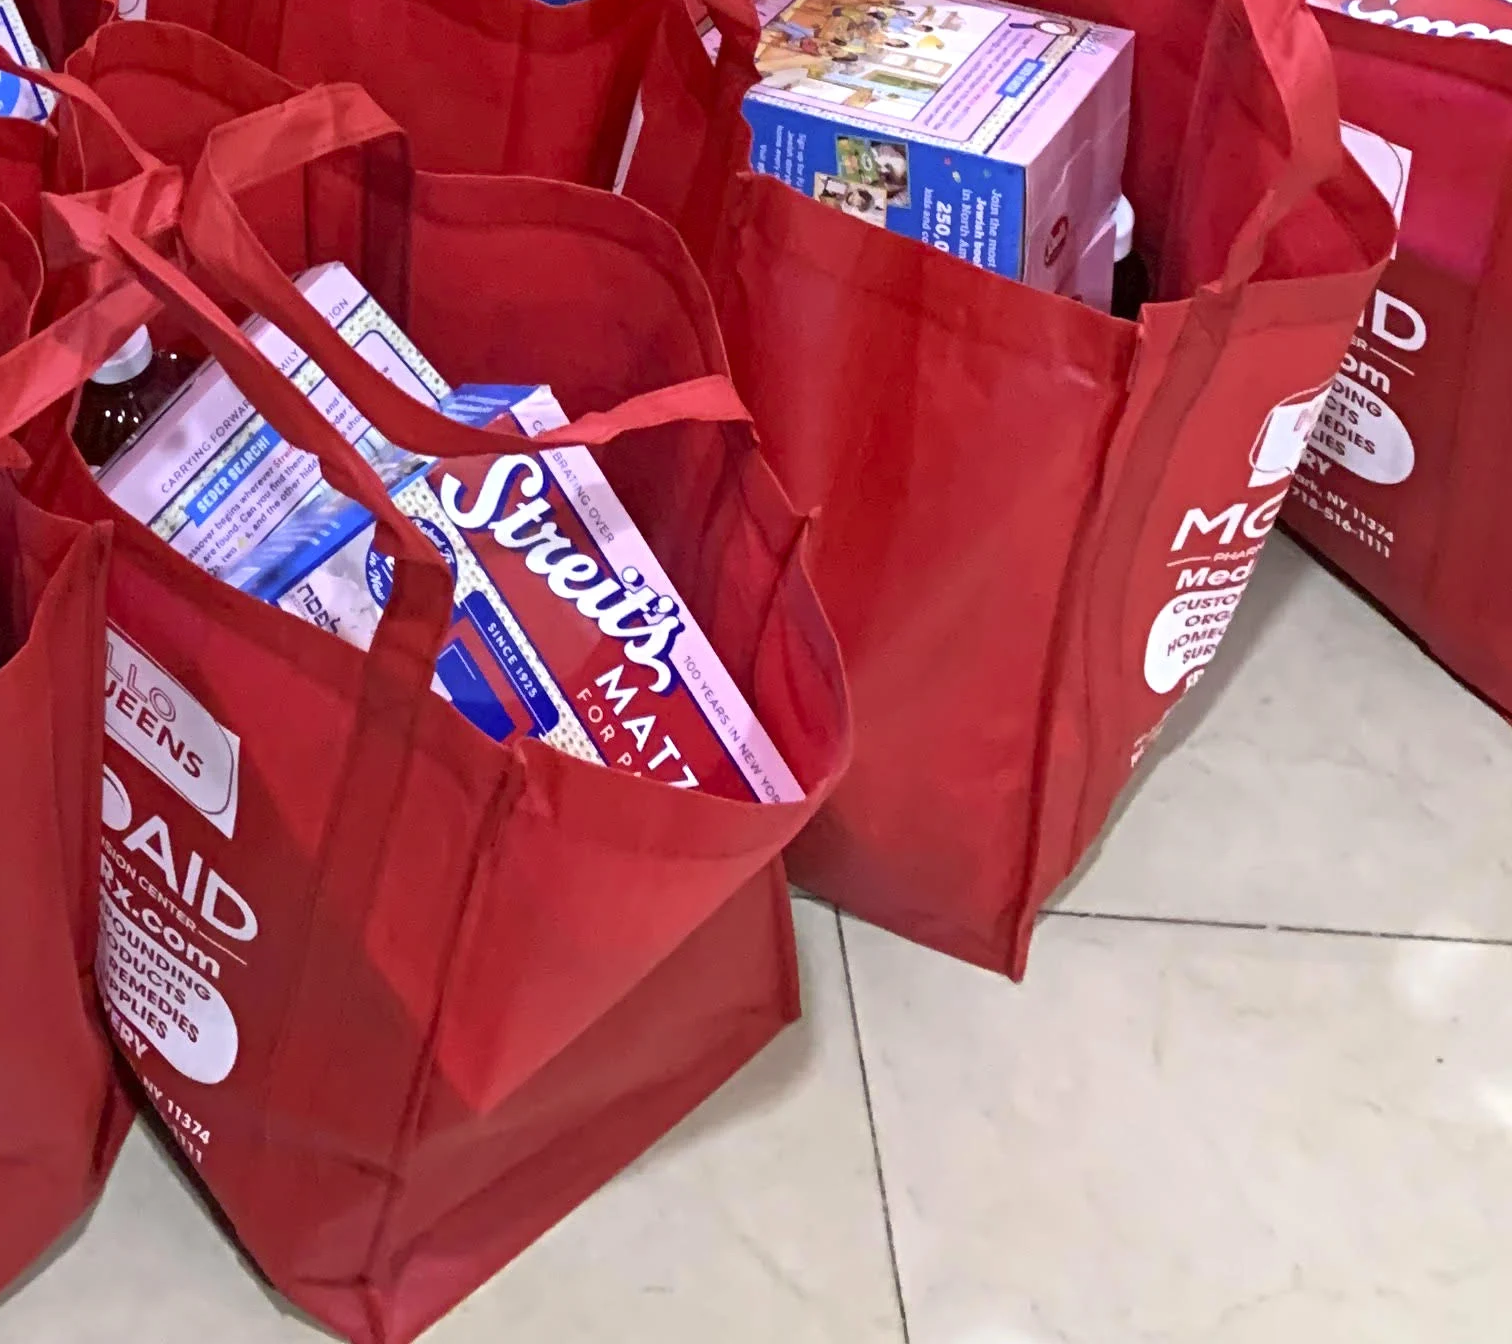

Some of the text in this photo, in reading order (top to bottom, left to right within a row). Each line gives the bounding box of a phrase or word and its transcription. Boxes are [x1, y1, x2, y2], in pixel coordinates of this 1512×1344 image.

[933, 200, 954, 254] 250,0
[159, 440, 213, 494] CARRYING
[195, 433, 272, 514] SEDER SEARCH!
[202, 452, 307, 564] are found. Can you find them
[216, 466, 277, 531] begins wherever
[251, 515, 269, 533] and
[265, 500, 282, 519] the
[278, 482, 299, 507] other
[1325, 490, 1395, 544] NY 11374
[368, 568, 387, 602] New
[440, 450, 686, 696] Streit's
[1172, 591, 1239, 616] CUSTO
[486, 622, 539, 700] SINCE 1925
[587, 505, 763, 776] OVER 100 YEARS IN NEW
[105, 641, 177, 723] LLO
[575, 686, 617, 744] FOR
[138, 874, 198, 934] CENTER
[105, 934, 187, 1006] ODUCTS
[165, 1098, 212, 1146] 11374
